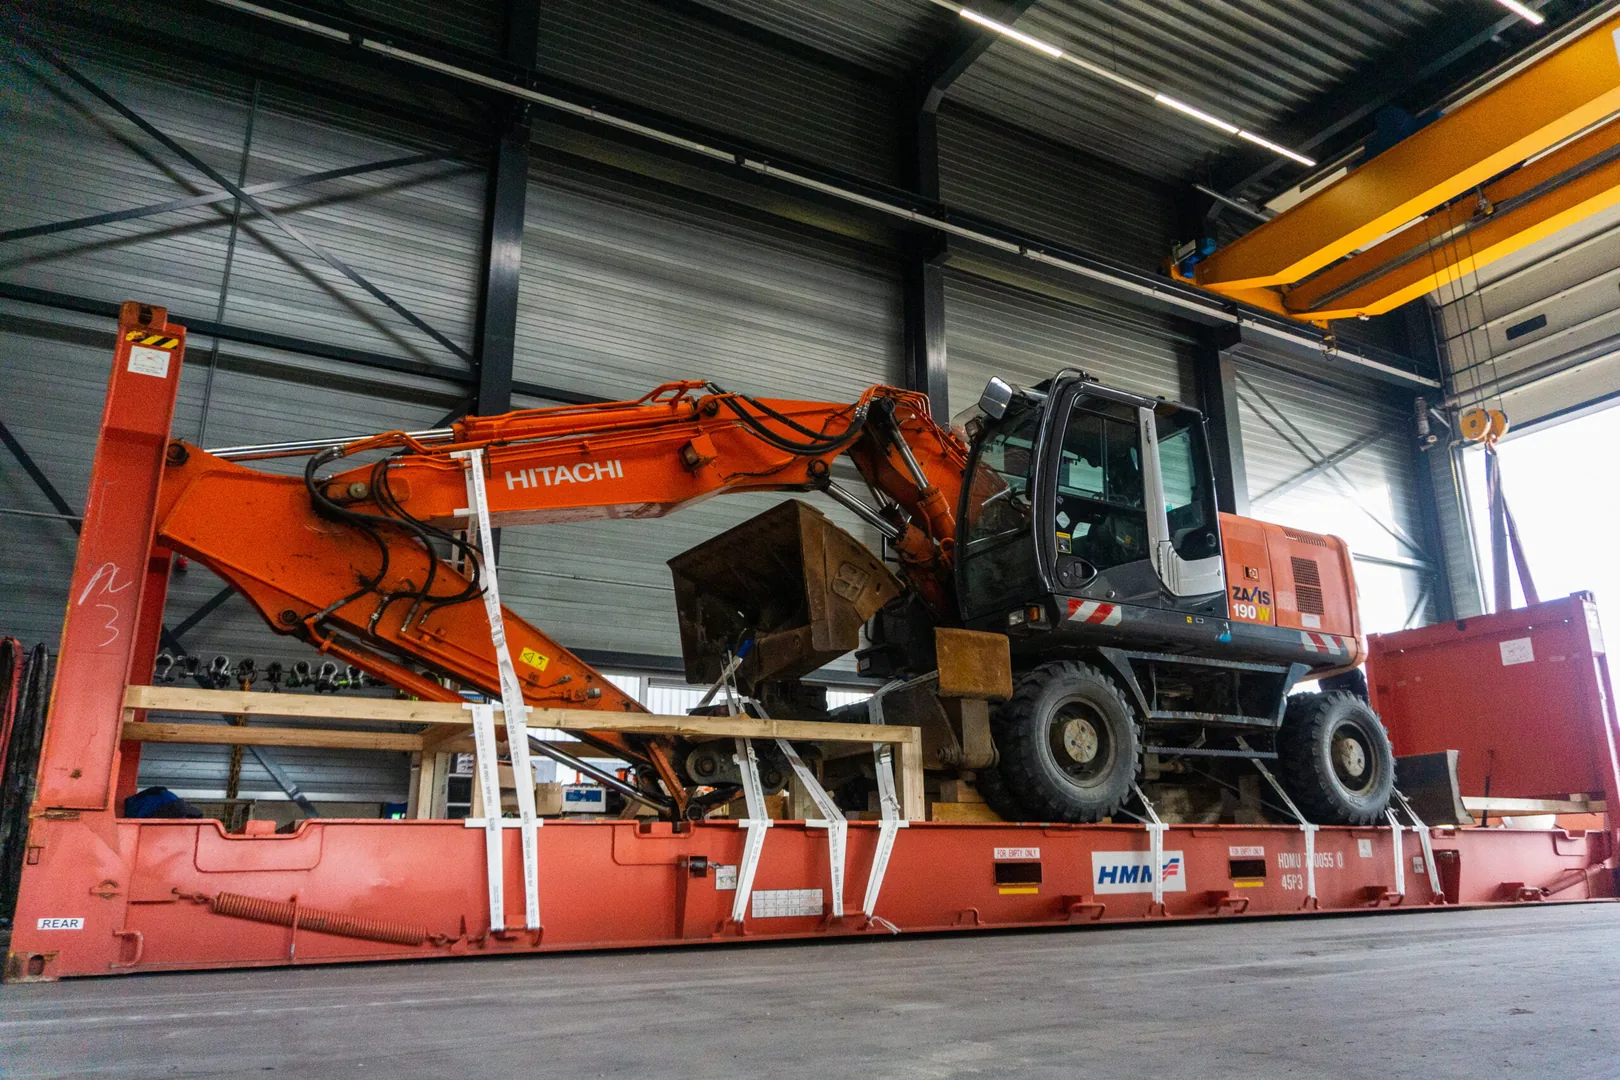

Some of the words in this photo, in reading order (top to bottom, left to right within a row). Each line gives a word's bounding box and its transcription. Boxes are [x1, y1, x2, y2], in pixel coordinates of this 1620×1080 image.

[505, 459, 624, 490] HITACHI
[1277, 852, 1302, 869] HDMU
[1304, 852, 1334, 868] 70055
[1281, 874, 1304, 890] 45P3
[41, 919, 79, 929] REAR
